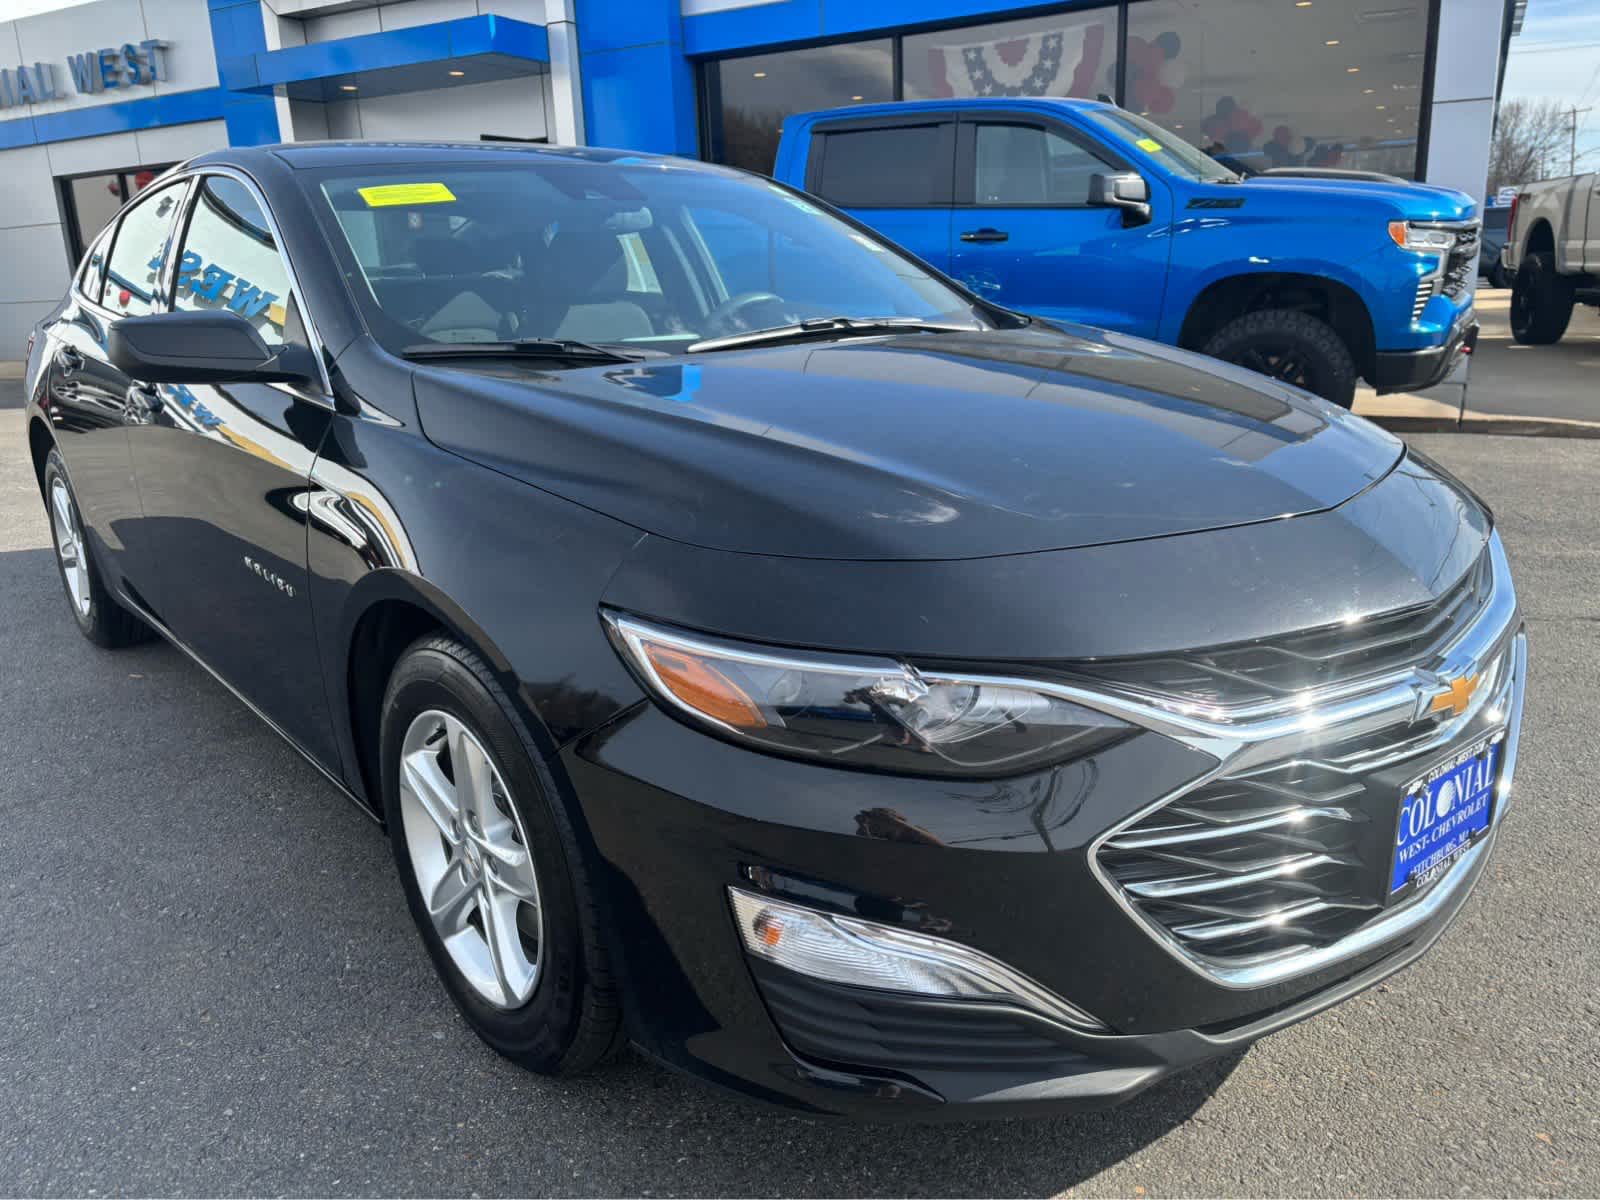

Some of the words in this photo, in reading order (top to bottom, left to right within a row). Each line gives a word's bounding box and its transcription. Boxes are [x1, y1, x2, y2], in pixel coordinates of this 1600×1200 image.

[67, 39, 168, 95] WEST
[1397, 752, 1495, 846] COLONIAL
[1431, 792, 1489, 842] CHEVROLET
